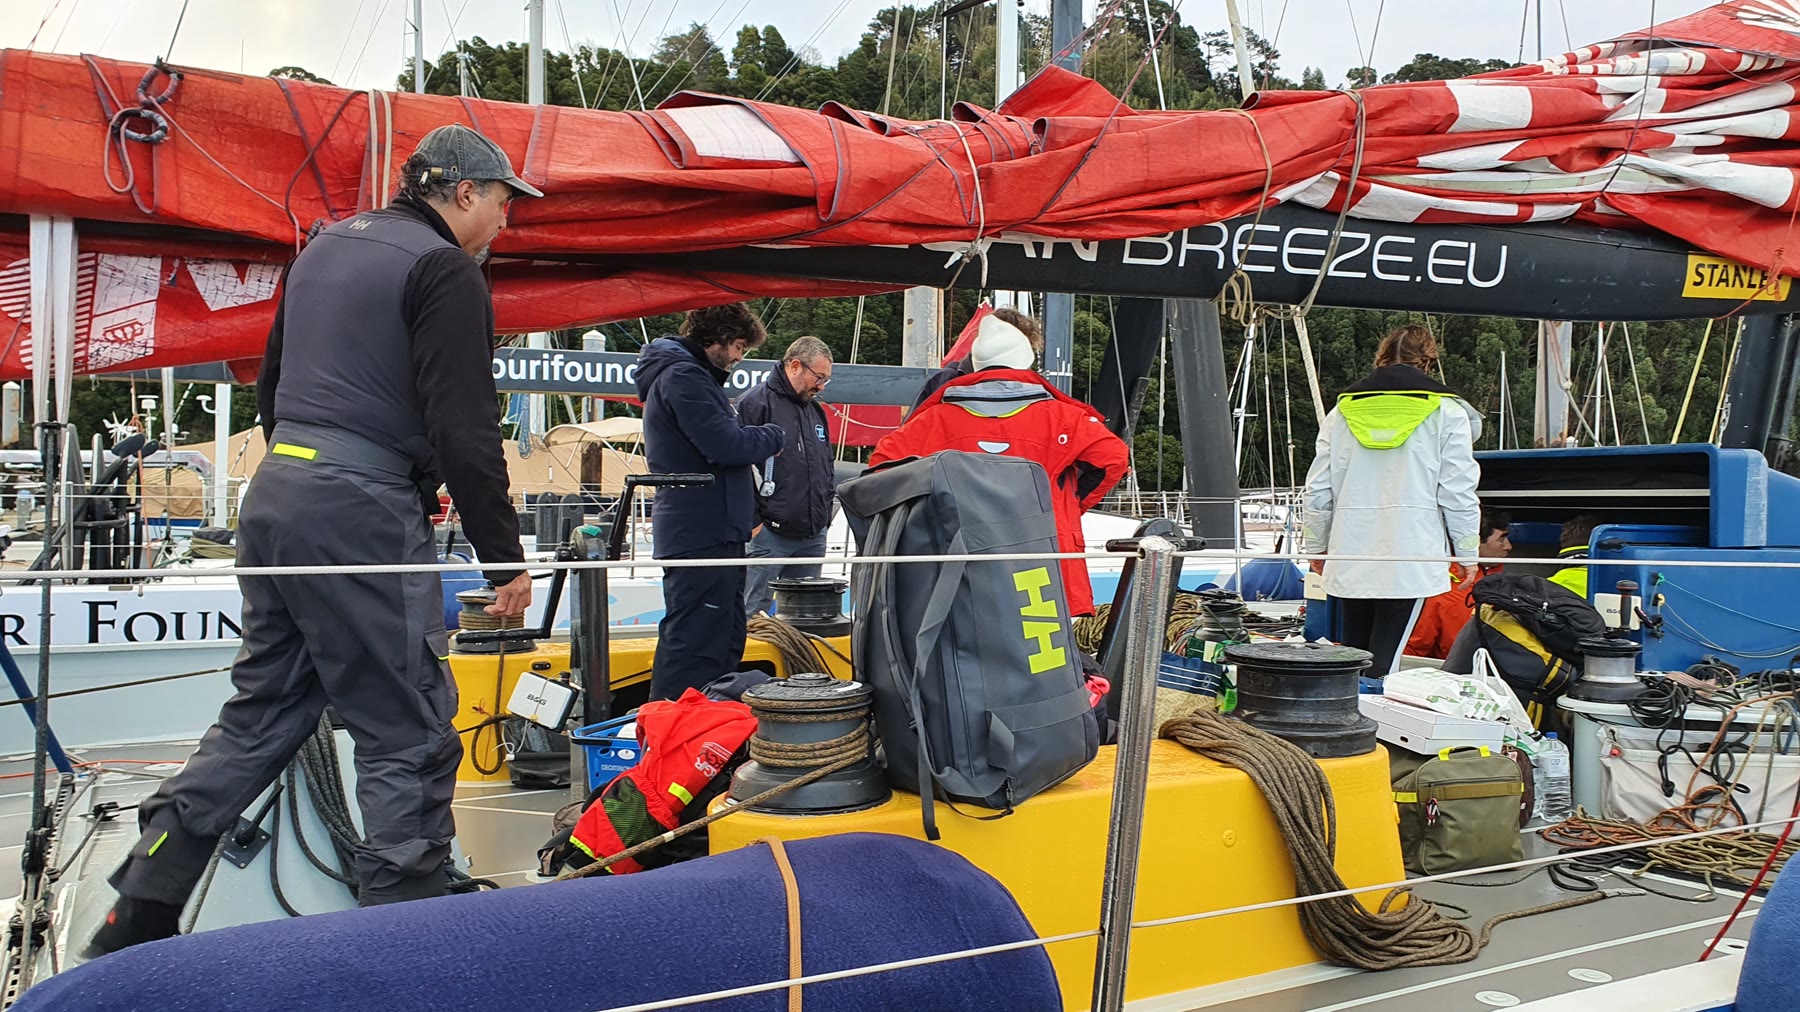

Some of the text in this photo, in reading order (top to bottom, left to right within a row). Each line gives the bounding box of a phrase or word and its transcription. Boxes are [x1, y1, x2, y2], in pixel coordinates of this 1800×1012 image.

[1122, 222, 1508, 288] BREEZE.EU
[1692, 262, 1784, 290] STANLE
[1012, 566, 1067, 674] HH
